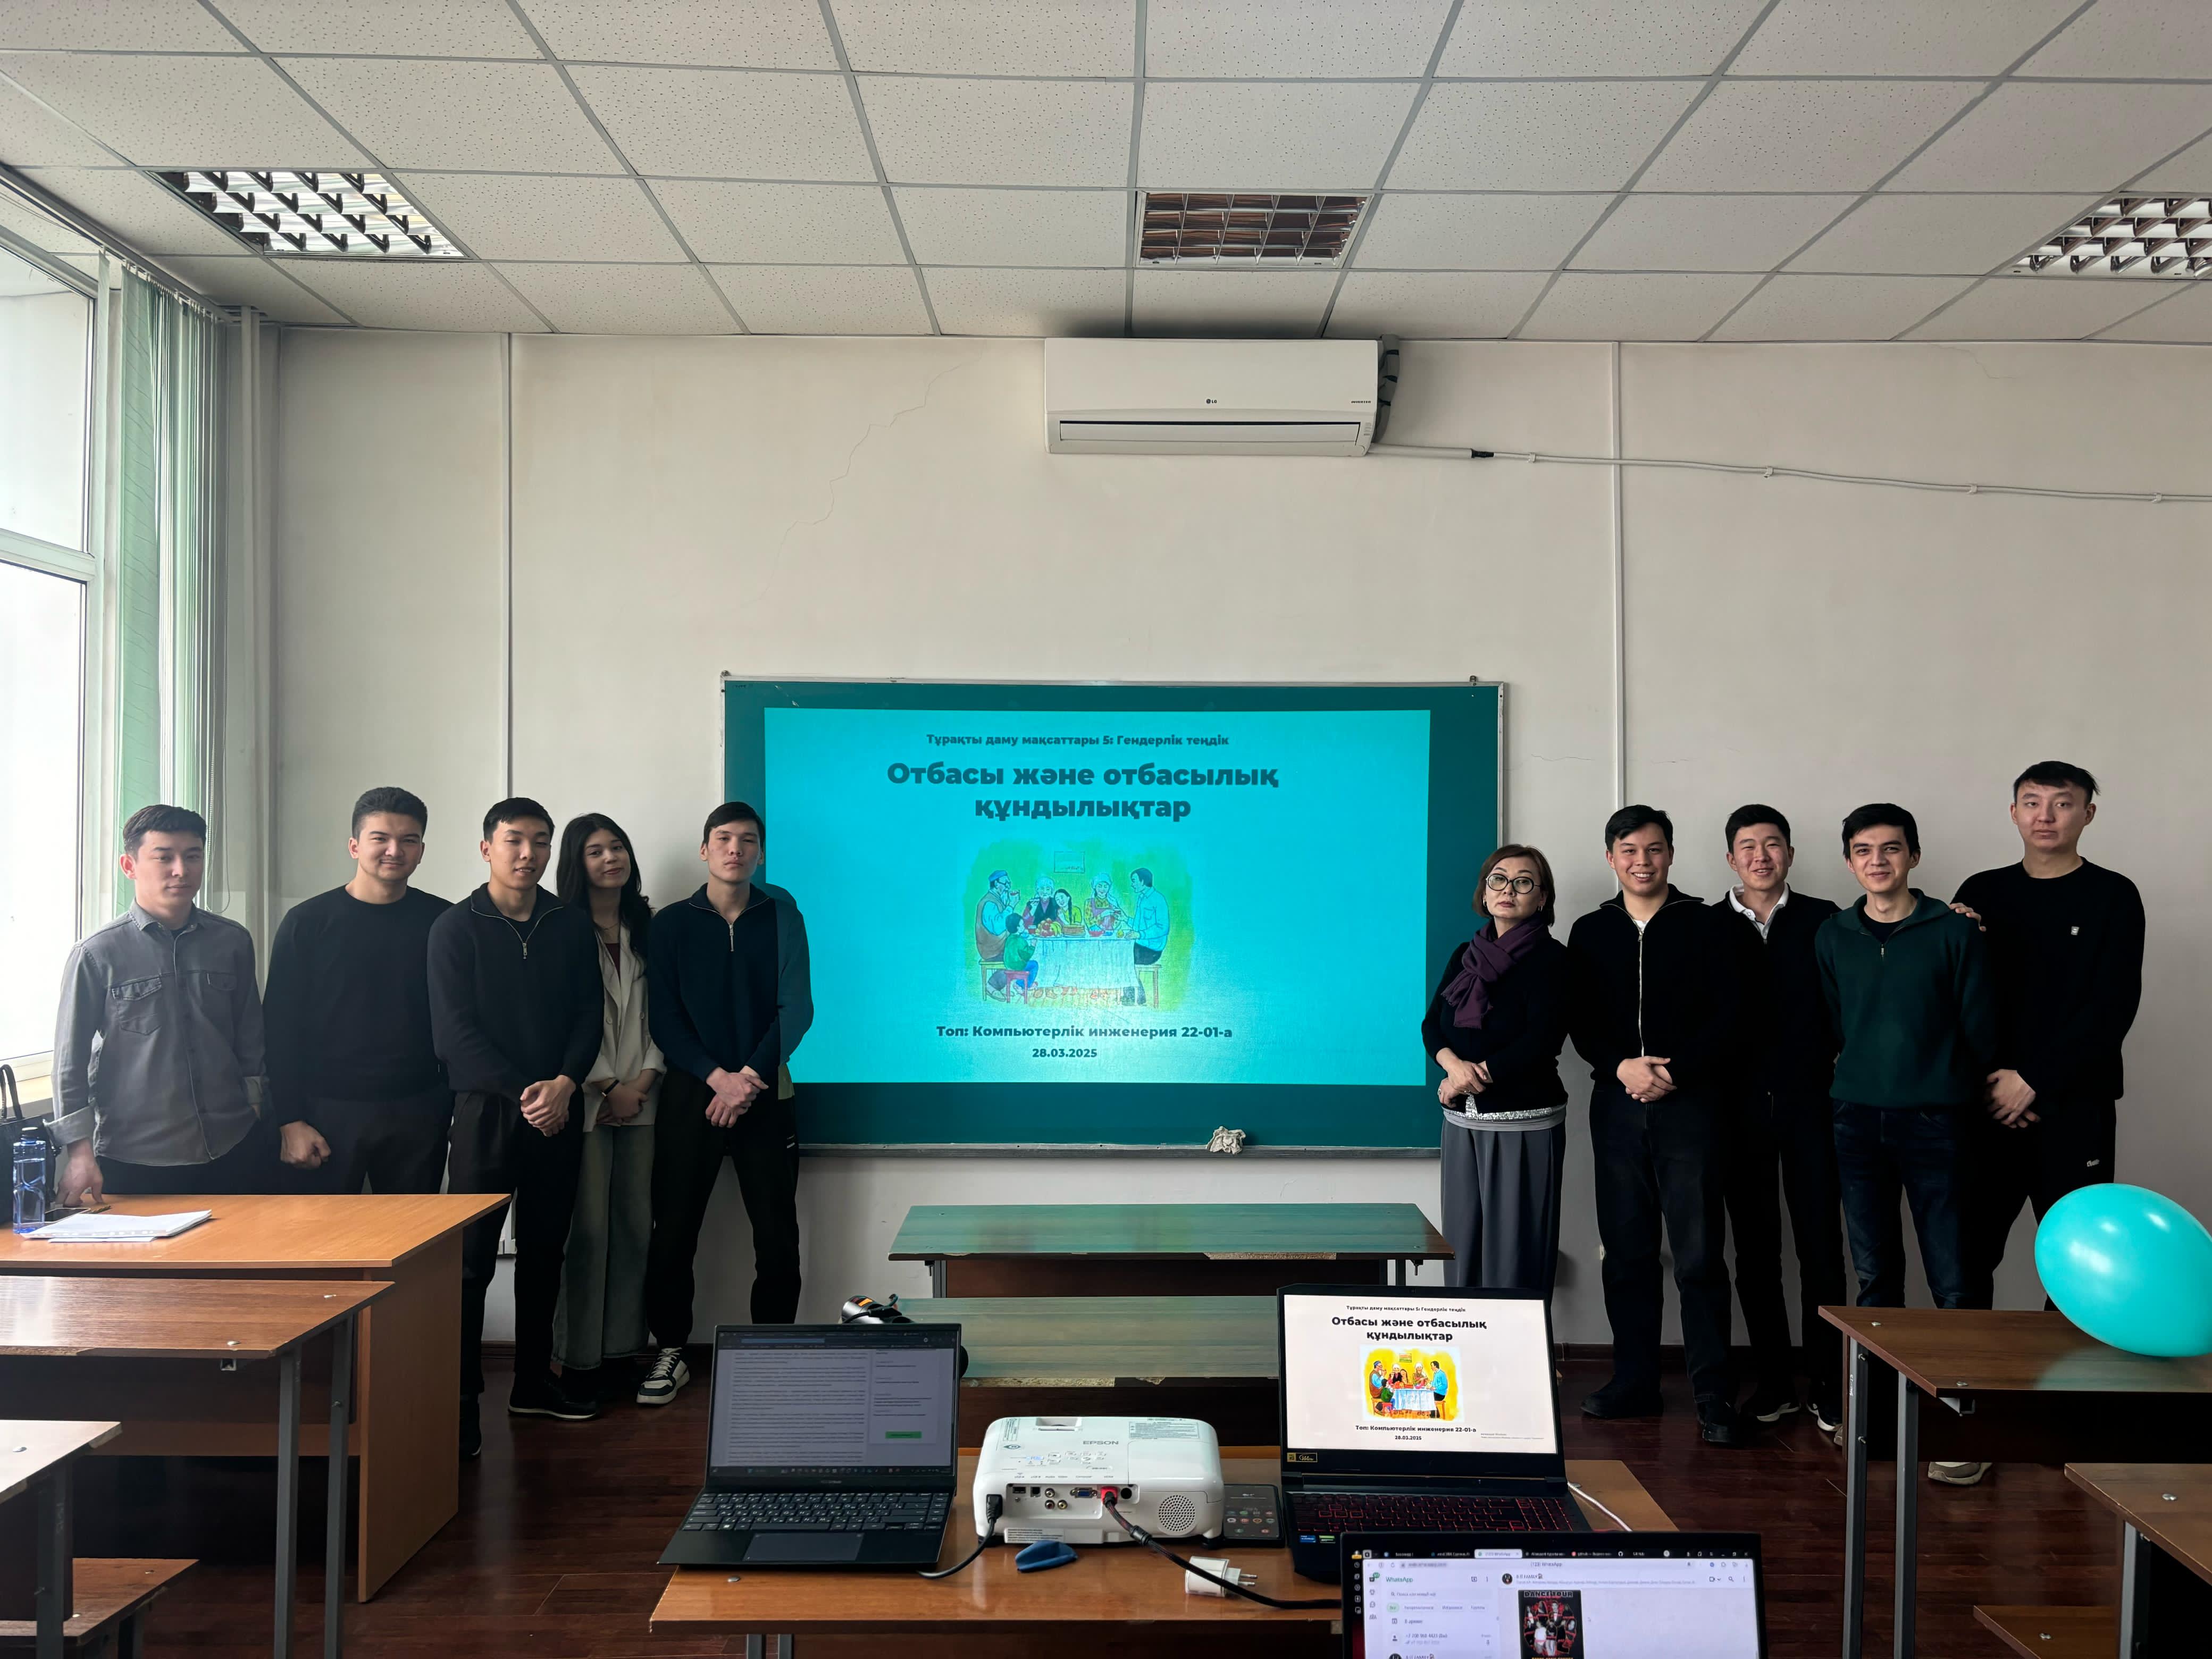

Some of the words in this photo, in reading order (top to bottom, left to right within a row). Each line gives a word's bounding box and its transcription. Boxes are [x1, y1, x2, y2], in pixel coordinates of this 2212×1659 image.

[926, 734, 982, 746] Тұрақты
[985, 736, 1019, 747] даму
[1022, 736, 1100, 747] мақсаттары
[1102, 735, 1114, 745] 5:
[1117, 734, 1183, 747] Гендерлік
[1186, 734, 1229, 747] теңдік
[887, 761, 1004, 785] Отбасы
[1012, 768, 1095, 785] және
[1103, 762, 1279, 789] отбасылық
[975, 799, 1192, 823] құндылықтар
[936, 1026, 969, 1037] Топ:
[973, 1025, 1084, 1039] Компьютерлік
[1088, 1028, 1177, 1040] инженерия
[1032, 1048, 1097, 1058] 28.03.2025
[1331, 1316, 1378, 1326] Отбасы
[1417, 1318, 1487, 1329] отбасылық
[1367, 1331, 1453, 1343] құндылықтар
